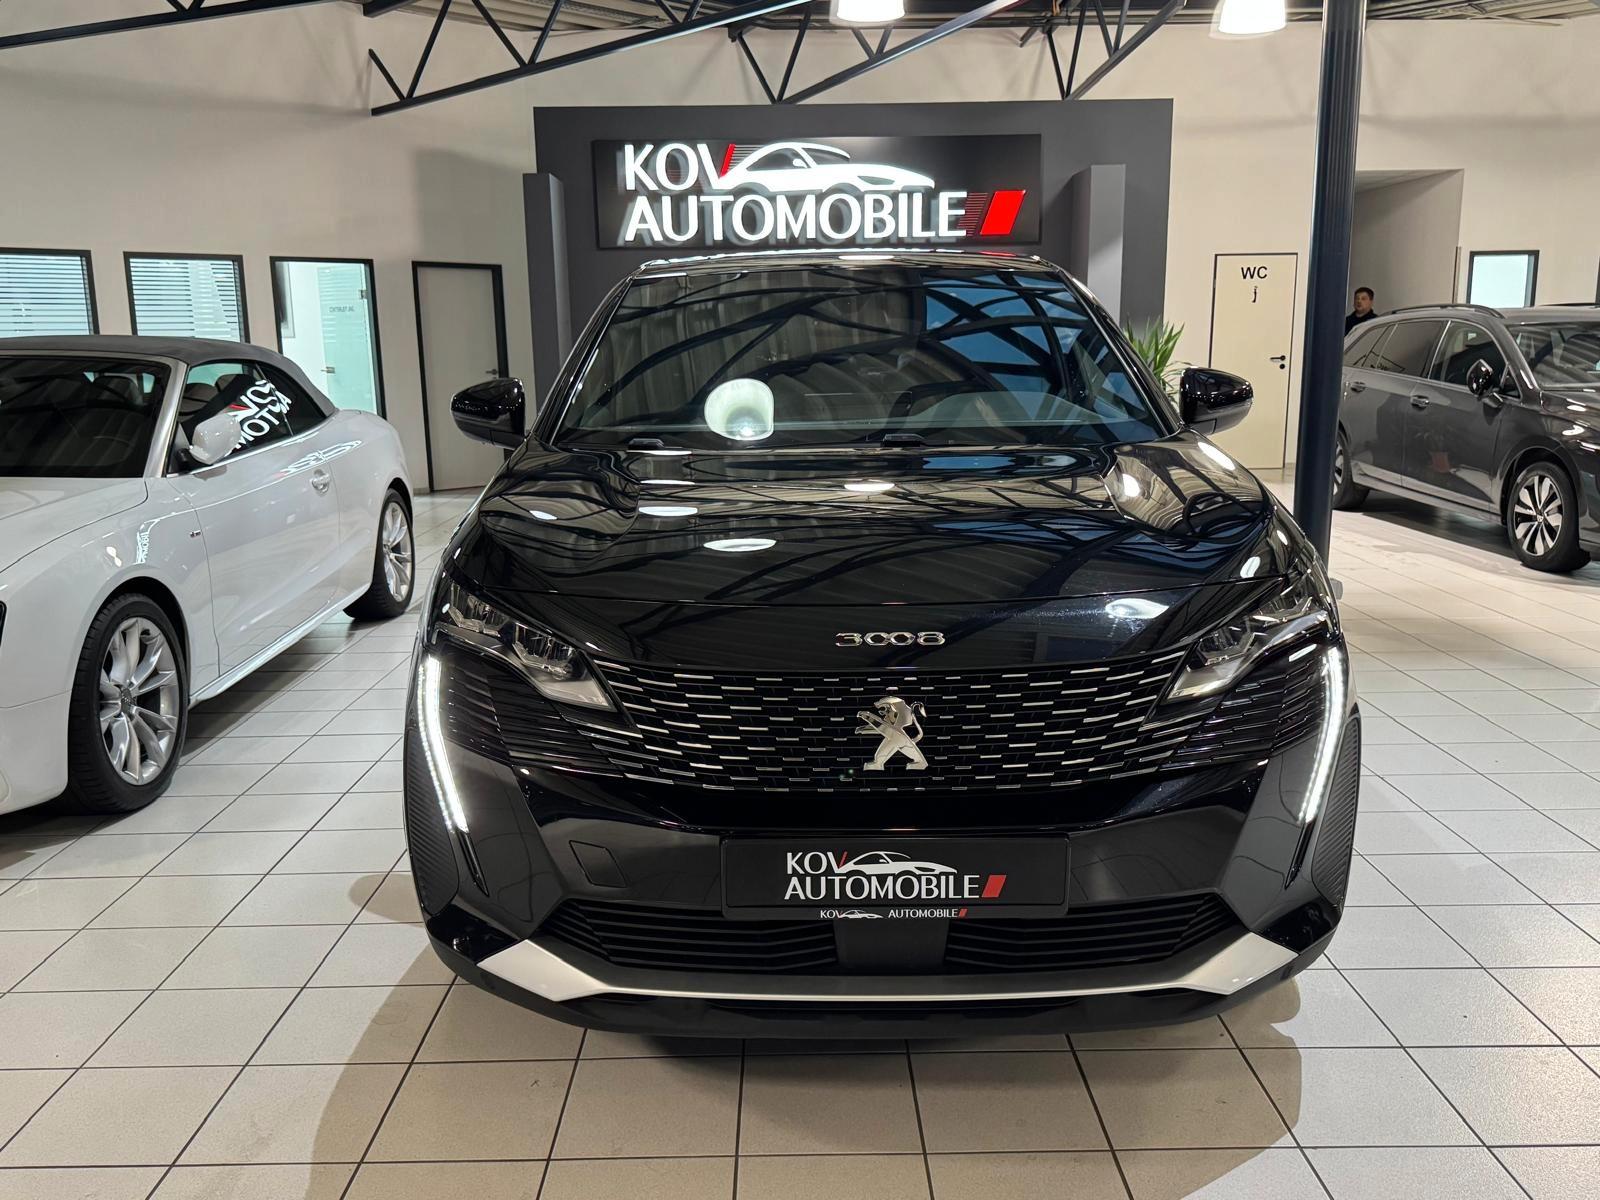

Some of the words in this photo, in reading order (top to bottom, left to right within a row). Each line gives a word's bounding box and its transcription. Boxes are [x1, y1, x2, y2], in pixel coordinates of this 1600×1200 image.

[624, 142, 735, 191] KOV
[624, 190, 967, 242] AUTOMOBILE
[1241, 265, 1268, 280] WC
[835, 631, 946, 647] 3008
[786, 851, 847, 875] KOV
[784, 874, 980, 900] AUTOMOBILE
[820, 910, 844, 919] KOV
[888, 908, 959, 919] AUTOMOBILE
